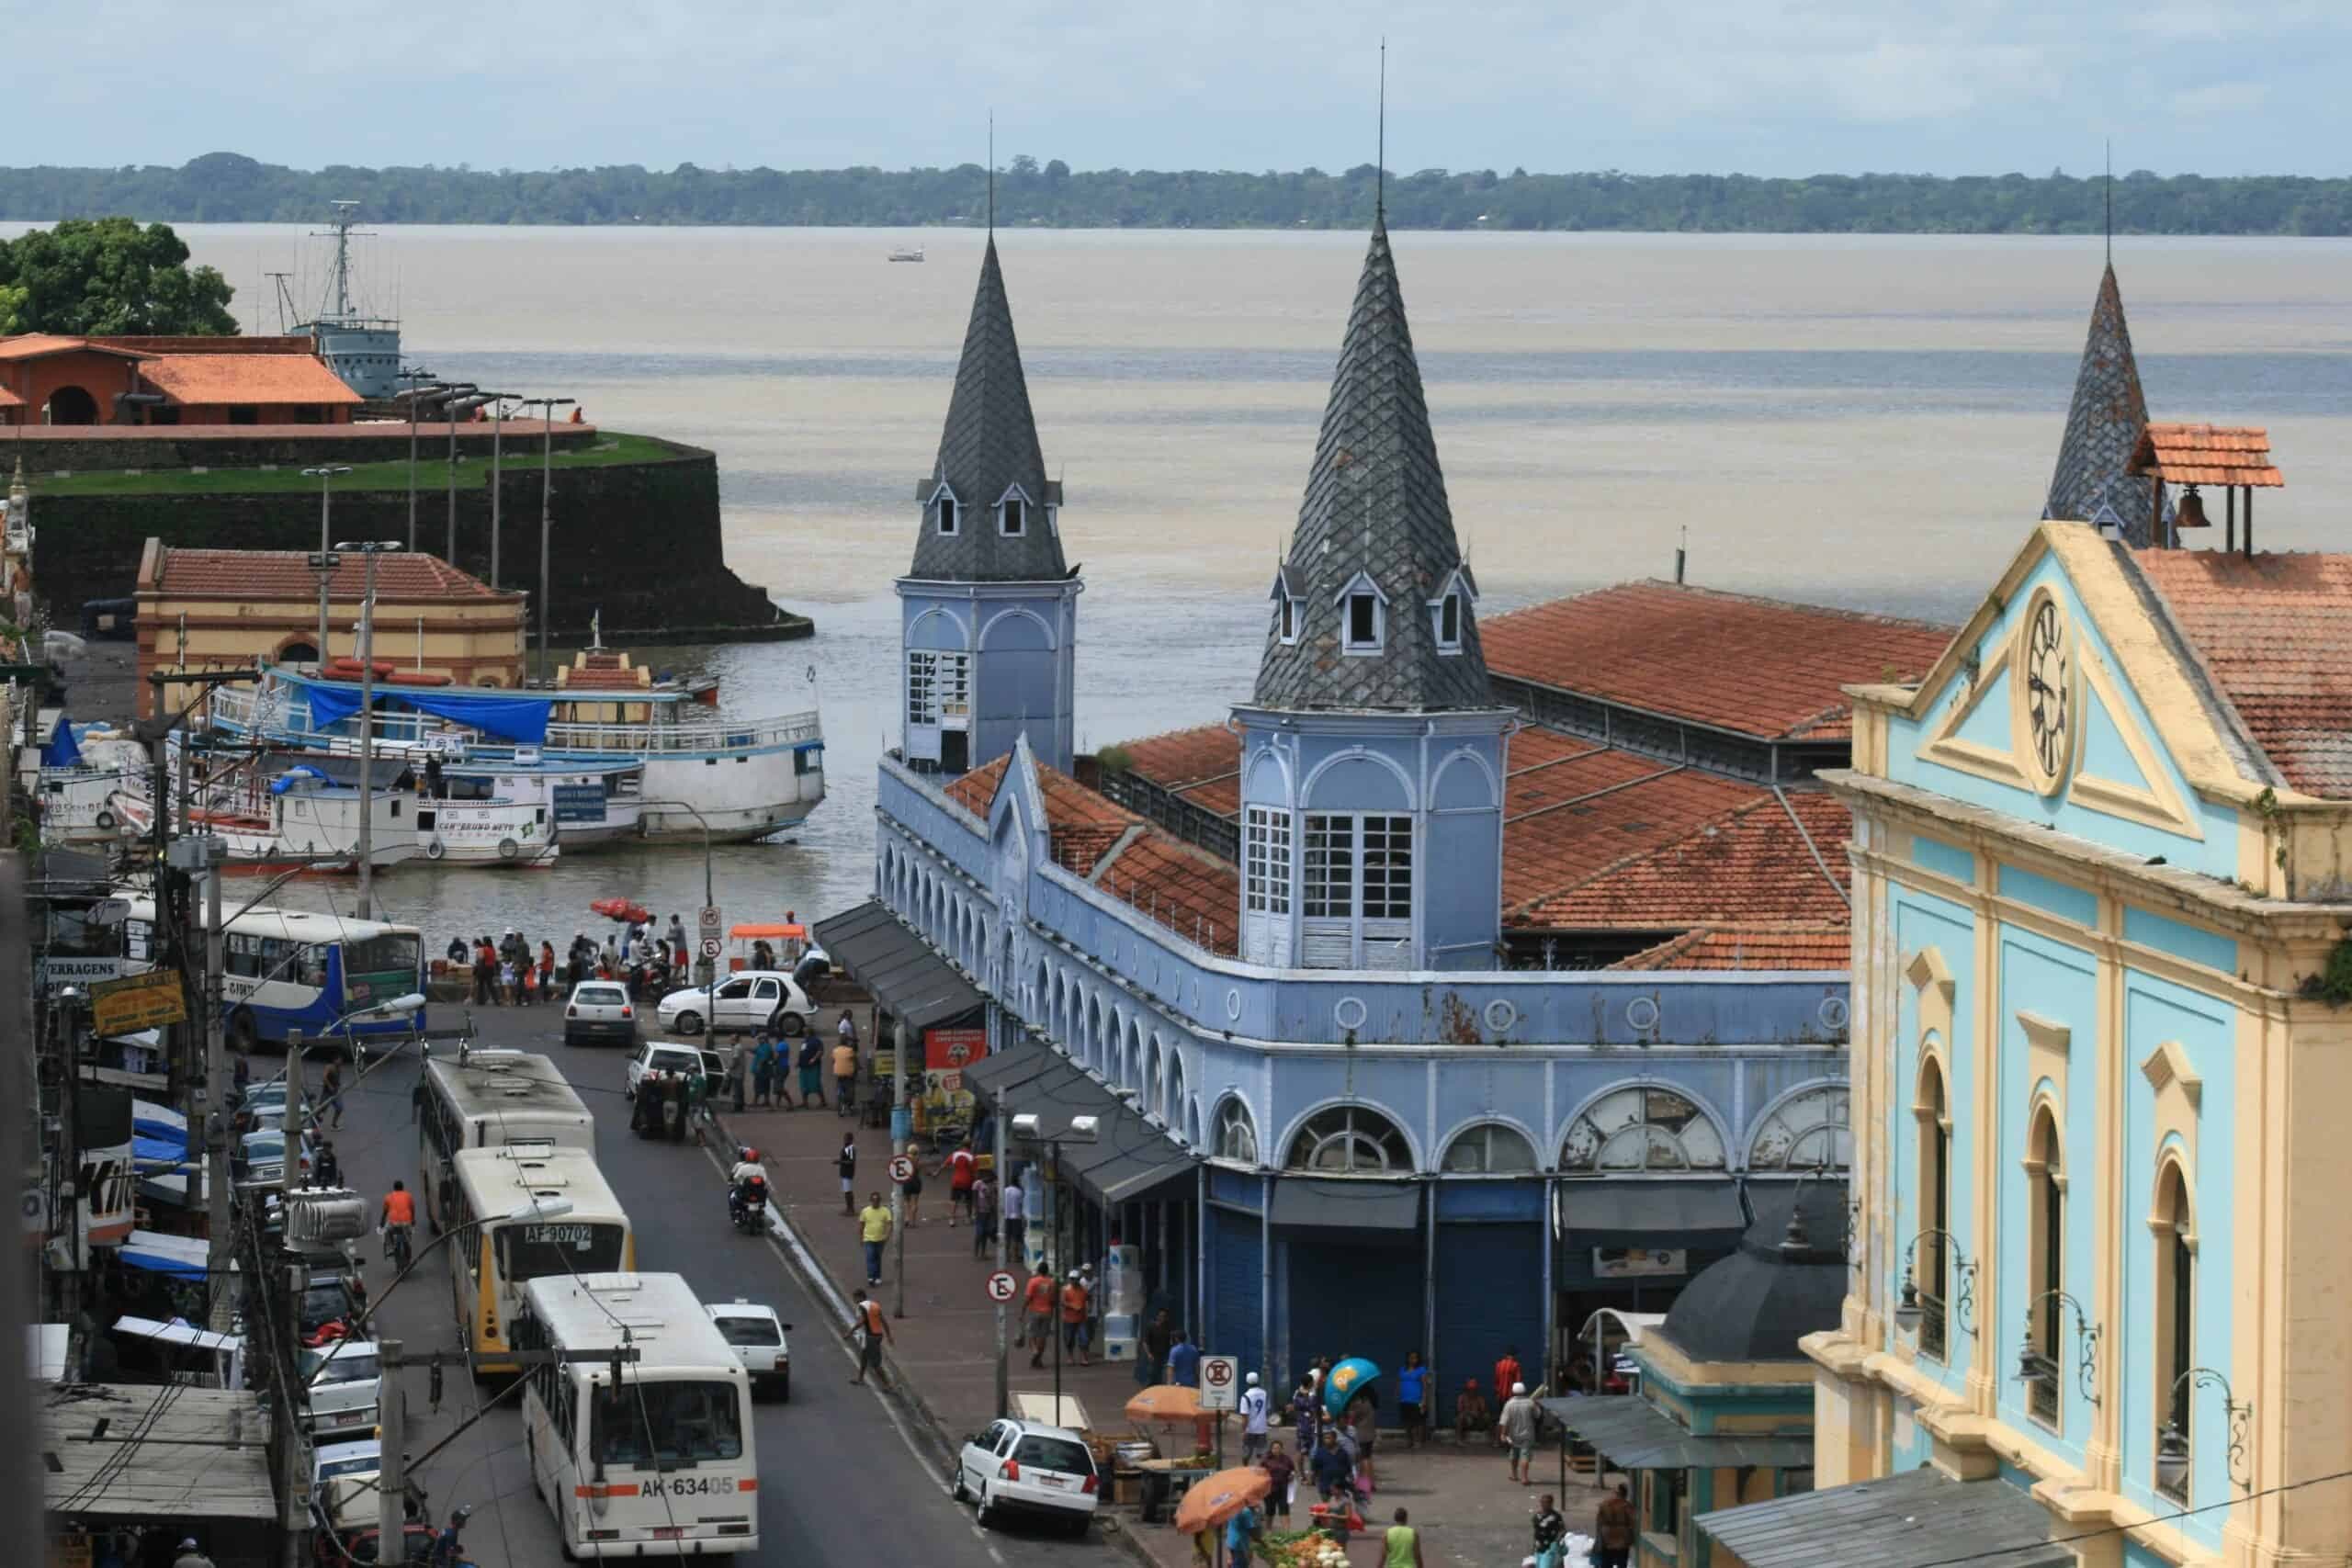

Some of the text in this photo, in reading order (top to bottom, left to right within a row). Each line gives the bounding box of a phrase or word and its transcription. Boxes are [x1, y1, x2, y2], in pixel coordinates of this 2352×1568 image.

[896, 1160, 907, 1177] E
[996, 1277, 1009, 1296] E
[1255, 1399, 1264, 1416] 9
